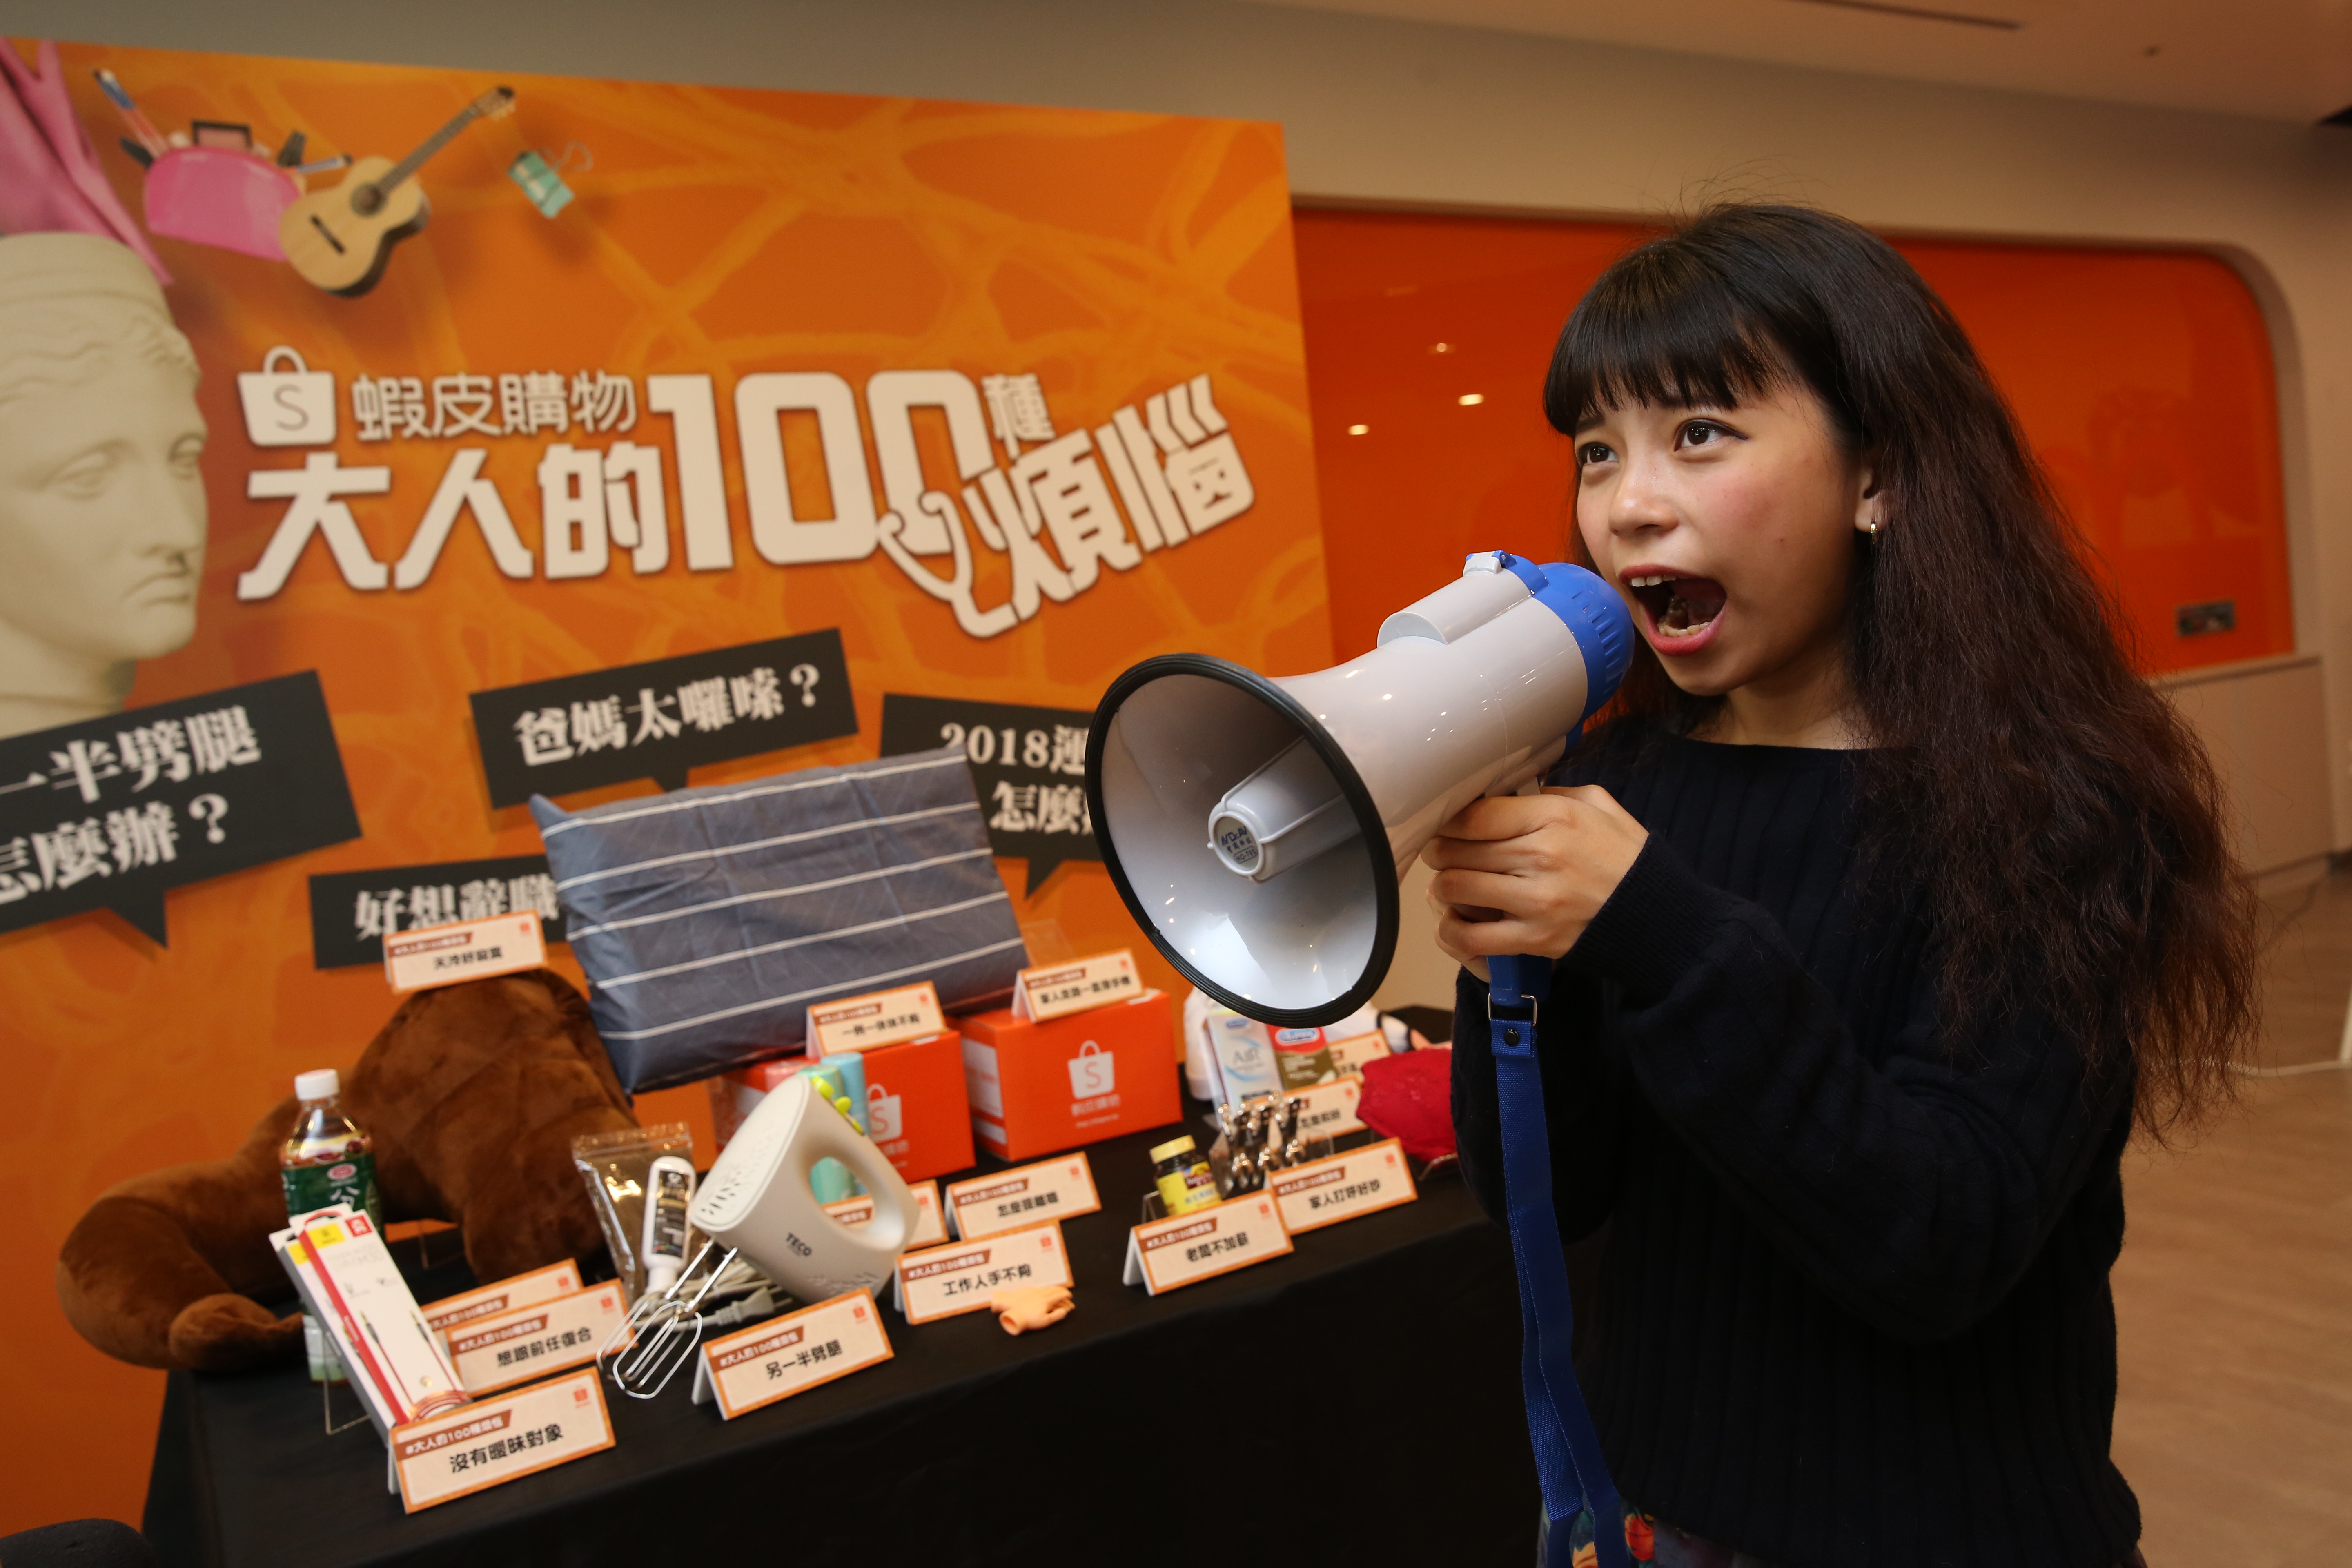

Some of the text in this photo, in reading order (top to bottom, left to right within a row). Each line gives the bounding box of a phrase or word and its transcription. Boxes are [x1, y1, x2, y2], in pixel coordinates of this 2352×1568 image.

[352, 370, 637, 440] 蝦皮購物
[514, 664, 819, 767] 爸媽太囉嗦？
[989, 780, 1093, 835] 怎麼
[786, 1232, 812, 1256] TECO
[766, 1339, 842, 1380] 另一半劈腿
[450, 1422, 563, 1474] 沒有曖昧對象
